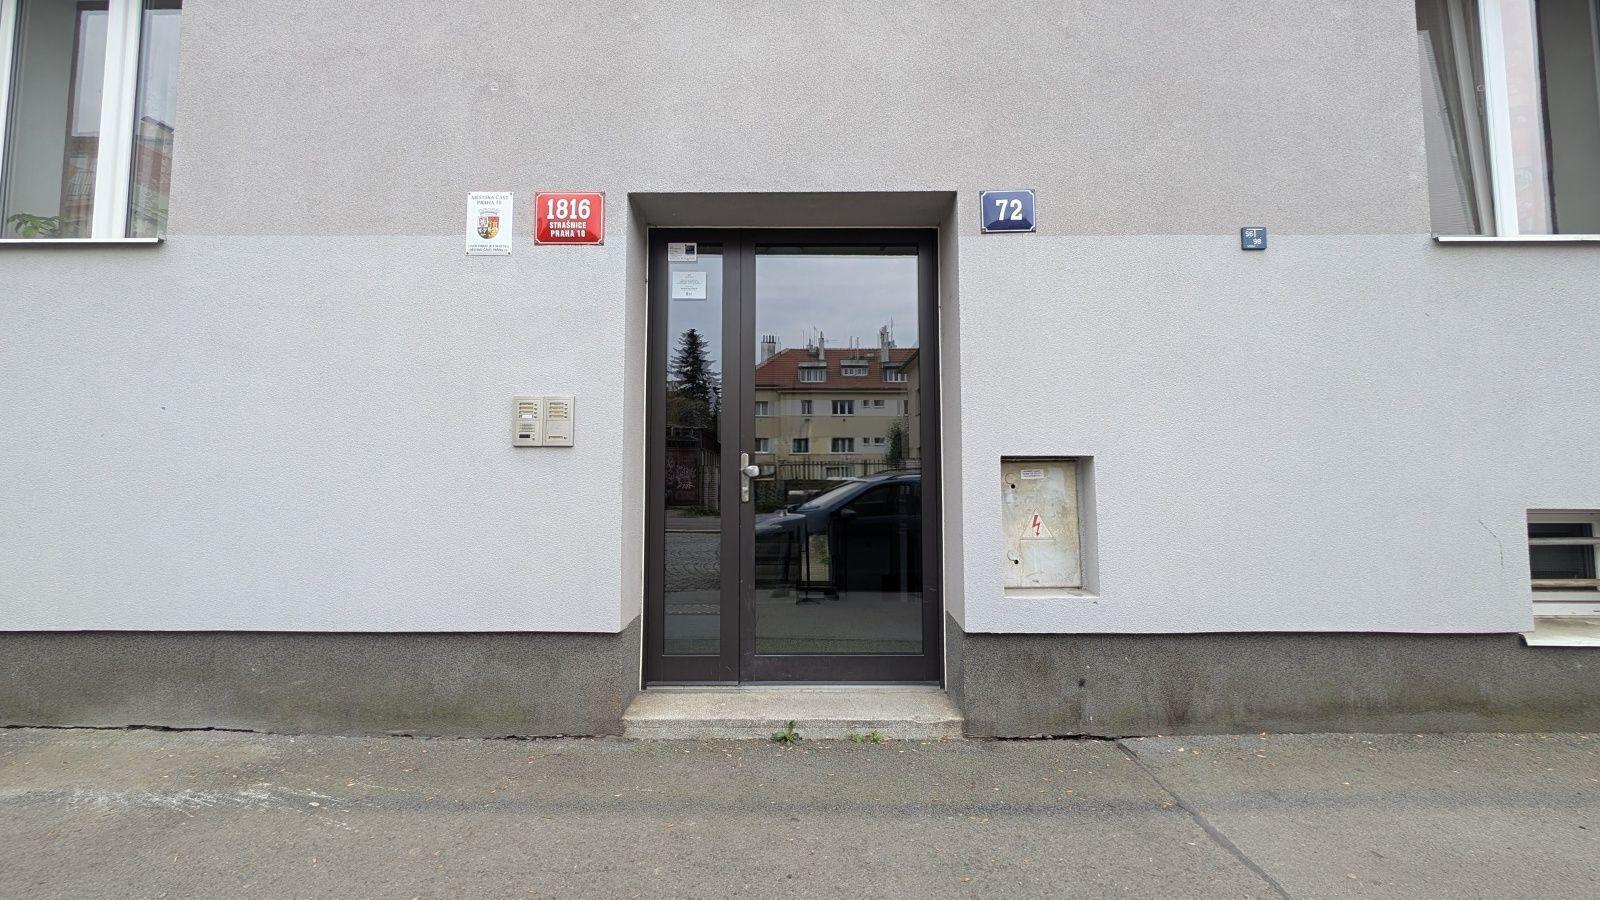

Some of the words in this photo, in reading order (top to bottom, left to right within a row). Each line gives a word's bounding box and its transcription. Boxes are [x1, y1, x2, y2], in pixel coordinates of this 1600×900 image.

[546, 198, 591, 220] 1816
[995, 199, 1023, 221] 72
[549, 220, 587, 229] STRAŠNICE
[550, 229, 575, 238] PRAHA
[576, 229, 586, 238] 10
